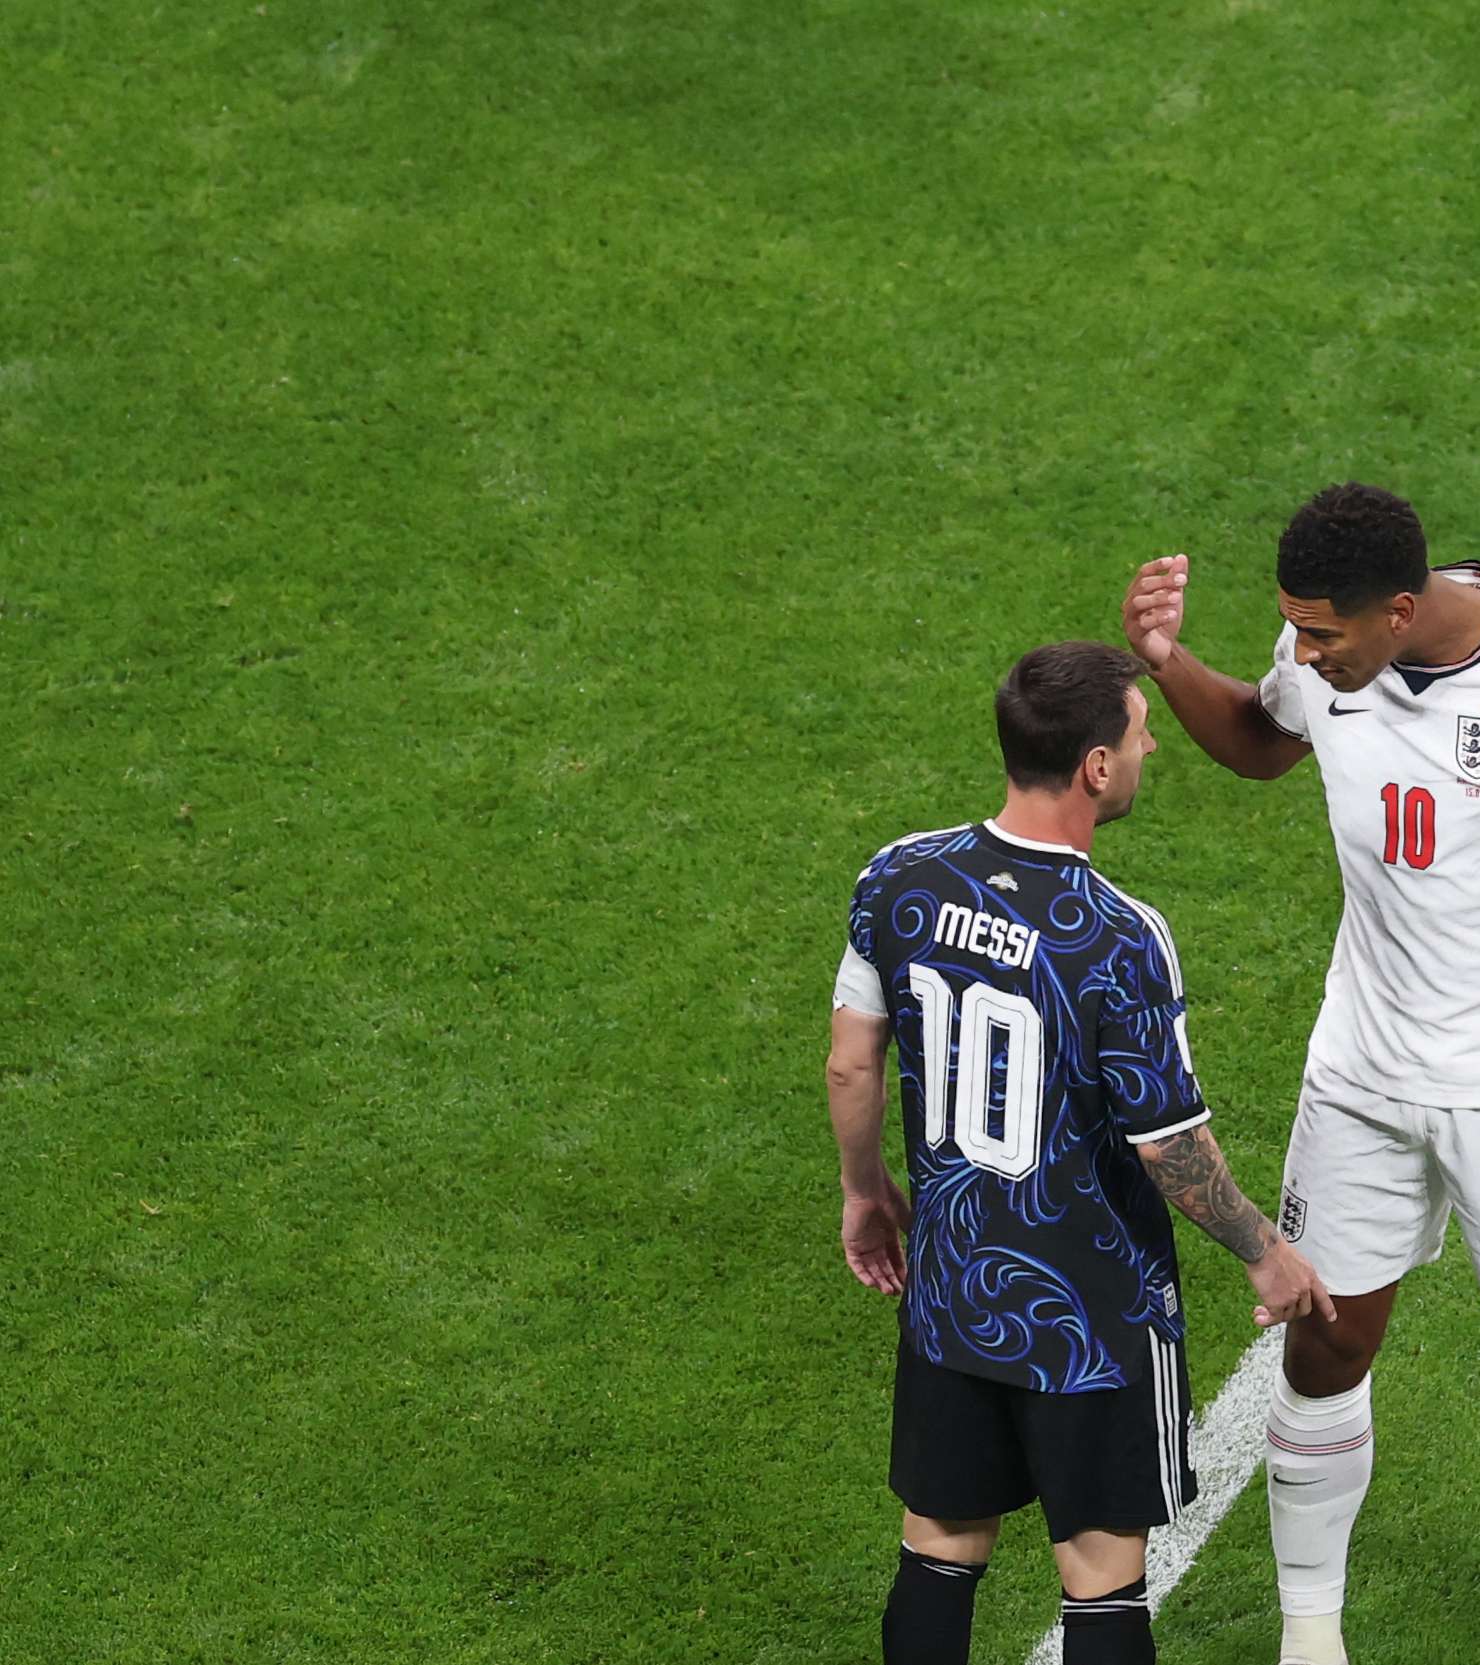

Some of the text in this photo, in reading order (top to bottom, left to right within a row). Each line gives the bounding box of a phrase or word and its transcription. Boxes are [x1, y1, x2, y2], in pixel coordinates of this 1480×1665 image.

[1380, 783, 1435, 870] 10
[934, 902, 1040, 971] MESSI
[909, 963, 1046, 1181] 10
